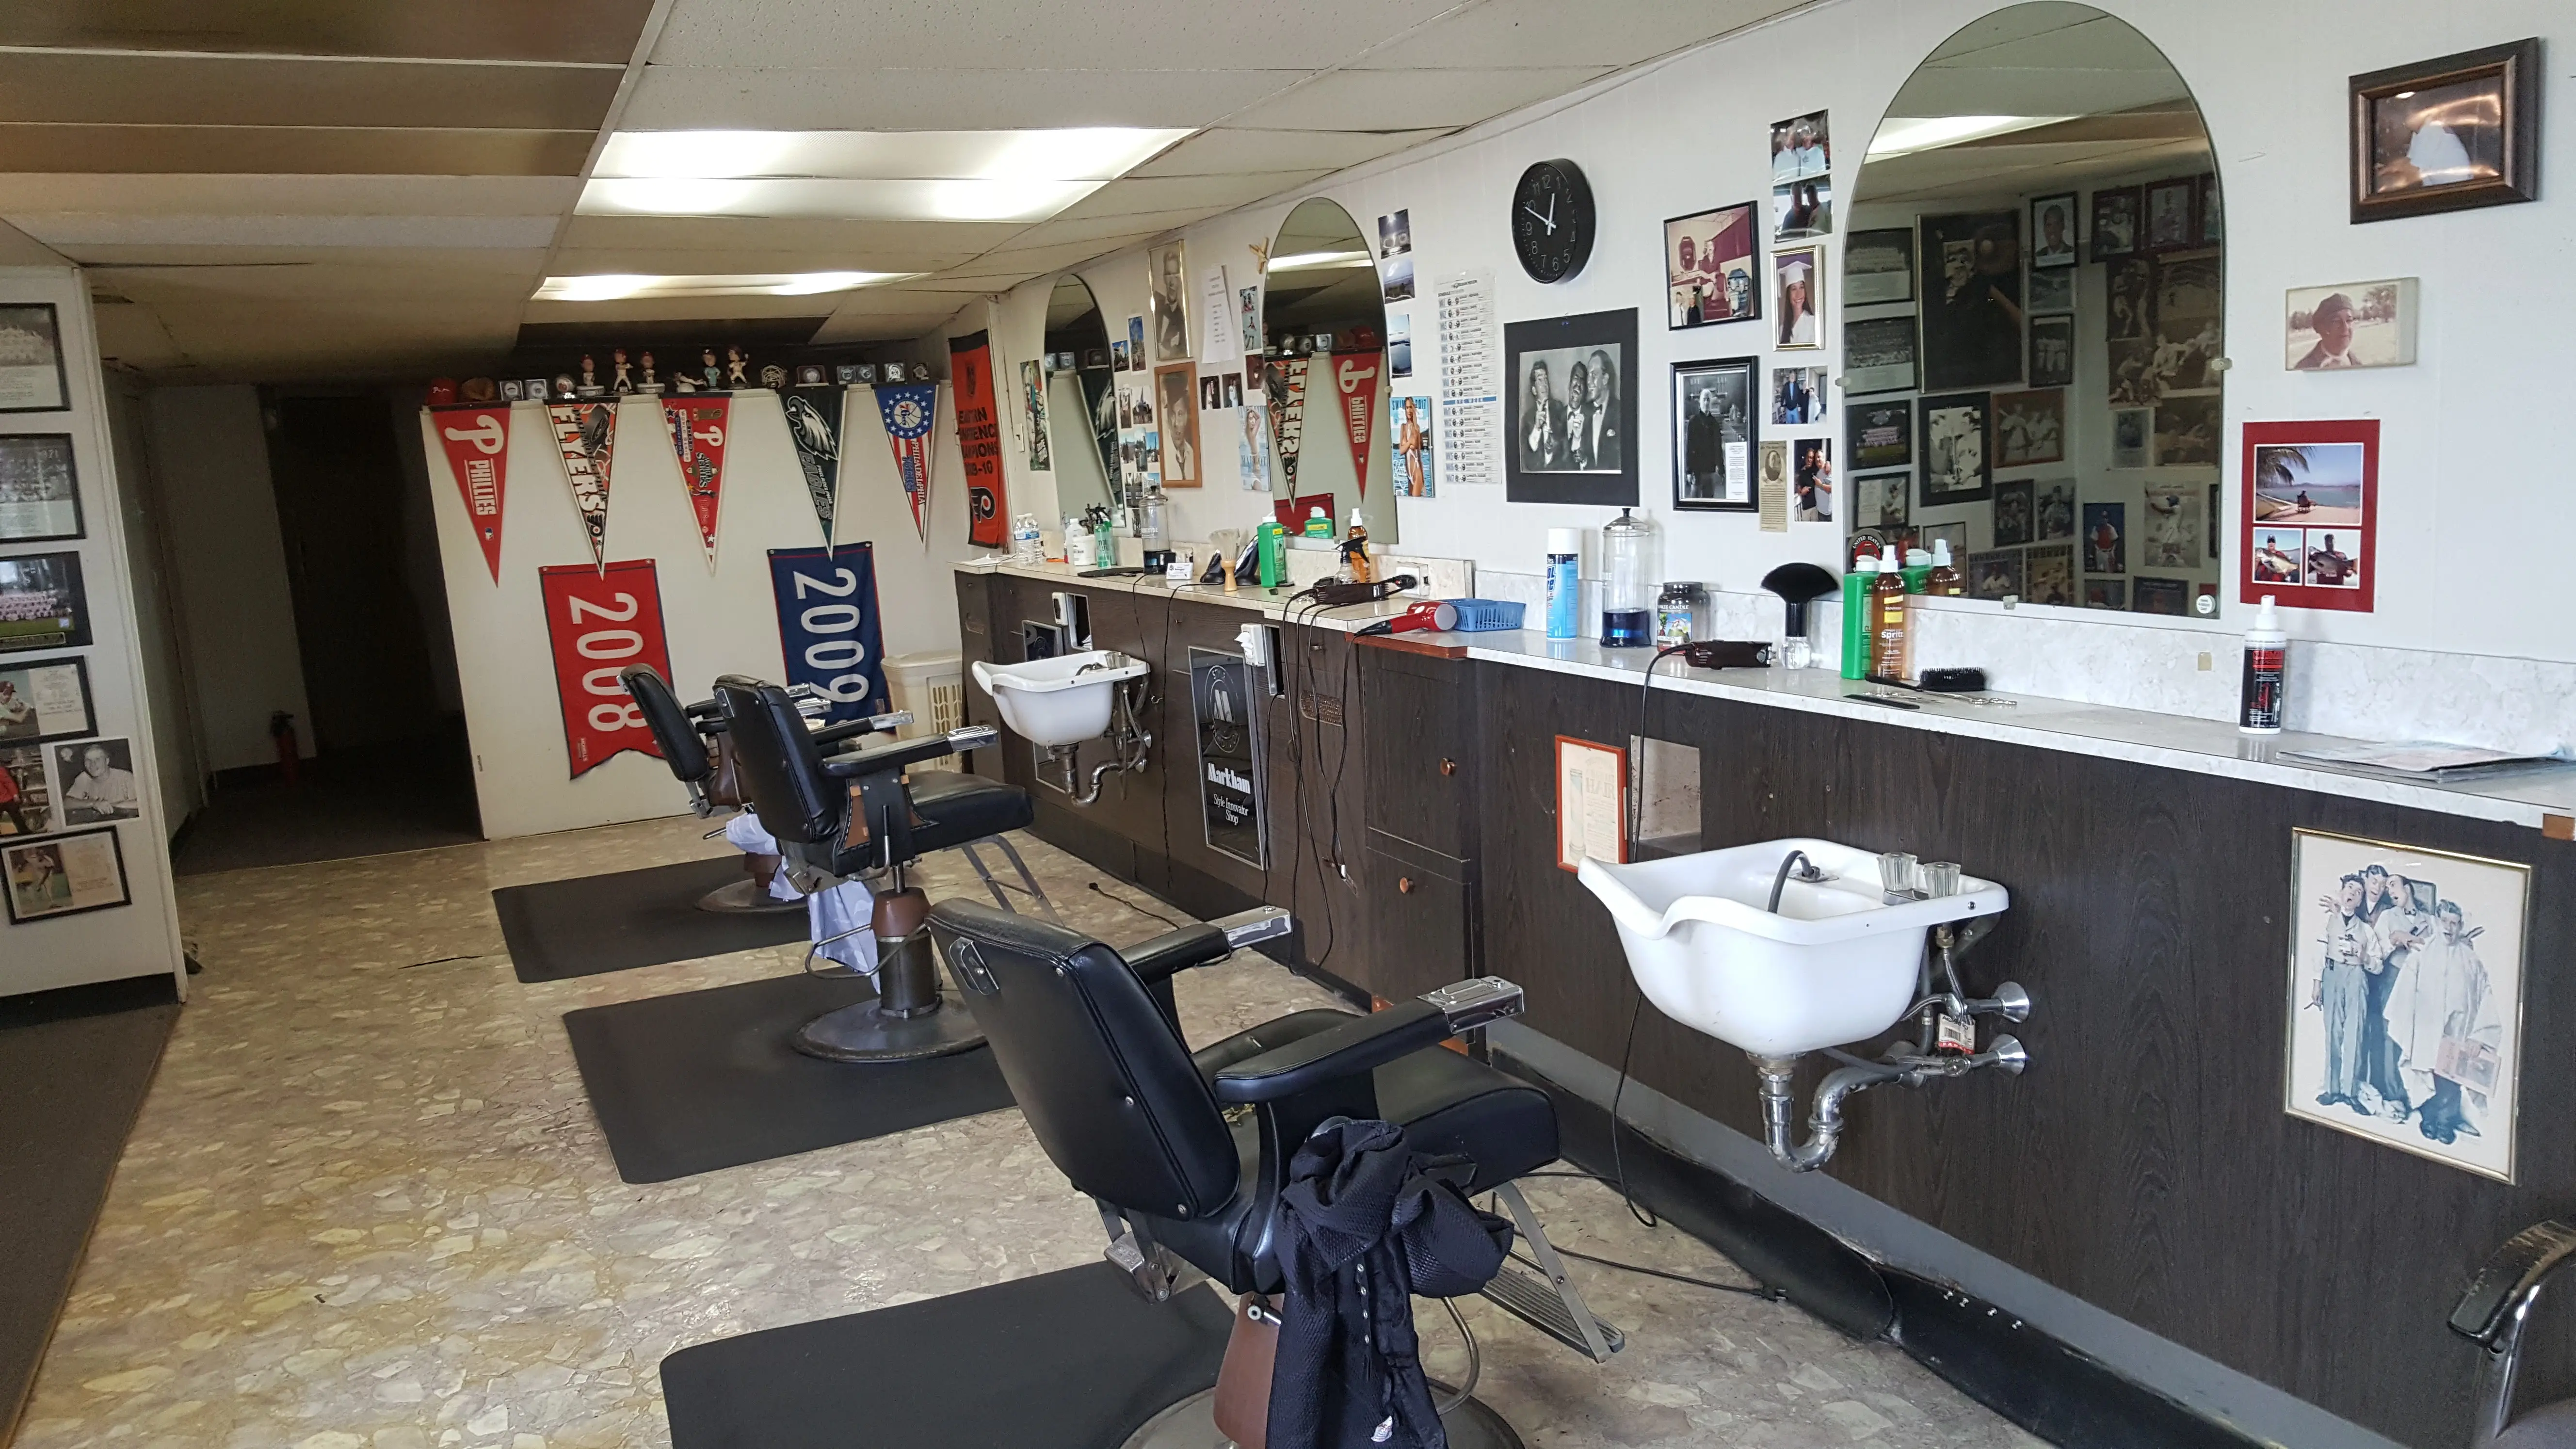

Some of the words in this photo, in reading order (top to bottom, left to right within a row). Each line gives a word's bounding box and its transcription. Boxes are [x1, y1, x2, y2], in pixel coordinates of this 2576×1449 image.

[1542, 175, 1551, 189] 12
[1526, 222, 1532, 235] 9
[1531, 241, 1538, 254] 8
[1563, 249, 1570, 262] 5
[1541, 255, 1547, 267] 7
[1553, 258, 1559, 271] 6
[445, 415, 504, 454] P
[693, 426, 724, 447] P
[551, 405, 606, 513] FLYERS
[695, 452, 708, 487] SERIES
[911, 439, 926, 505] PHILADELPHIA
[469, 460, 498, 515] PHILLIES
[799, 451, 833, 520] EAGLES
[1852, 535, 1866, 549] UNITED
[1868, 535, 1882, 549] STATES
[793, 567, 870, 703] 2009
[568, 592, 649, 732] 2008
[1208, 762, 1251, 795] Markham
[1213, 793, 1225, 808] Style
[1225, 798, 1249, 816] Innovator
[1225, 809, 1239, 826] Shop
